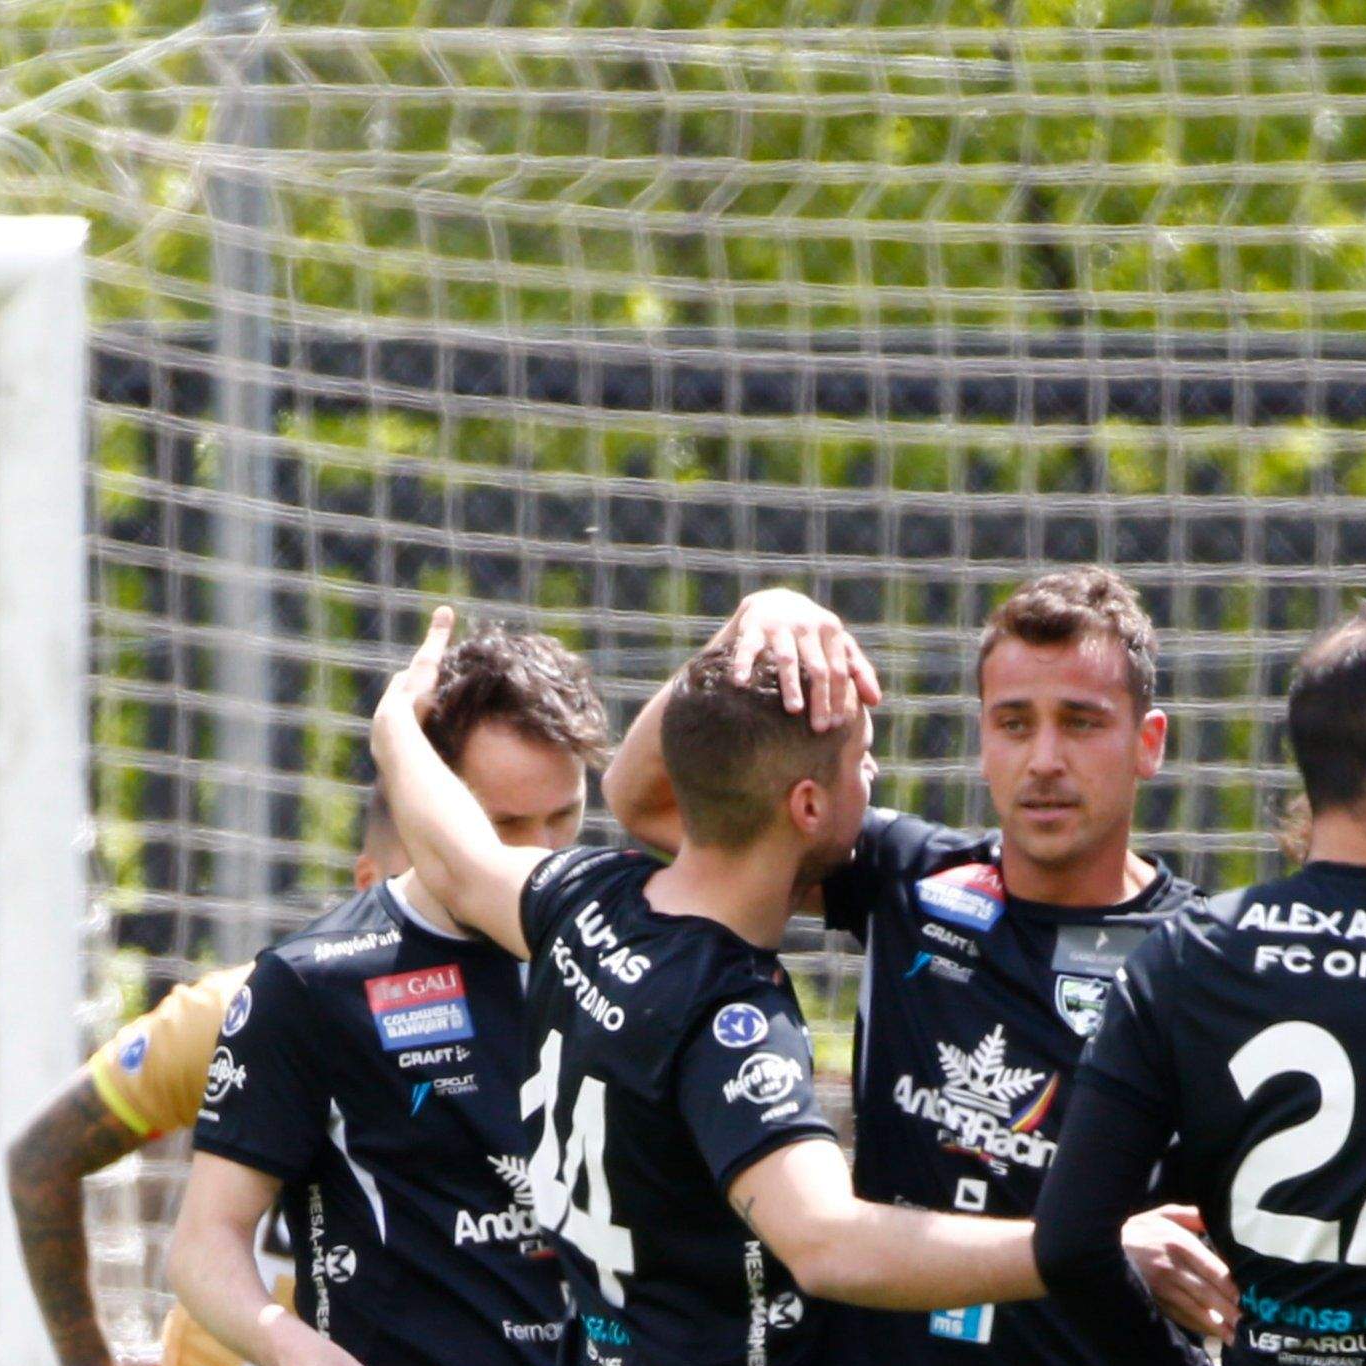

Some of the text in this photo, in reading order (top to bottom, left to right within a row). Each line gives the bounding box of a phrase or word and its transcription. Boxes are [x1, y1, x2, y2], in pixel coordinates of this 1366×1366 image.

[1236, 903, 1340, 935] ALEX
[1254, 946, 1315, 974] FC
[398, 1047, 454, 1069] CRAFT
